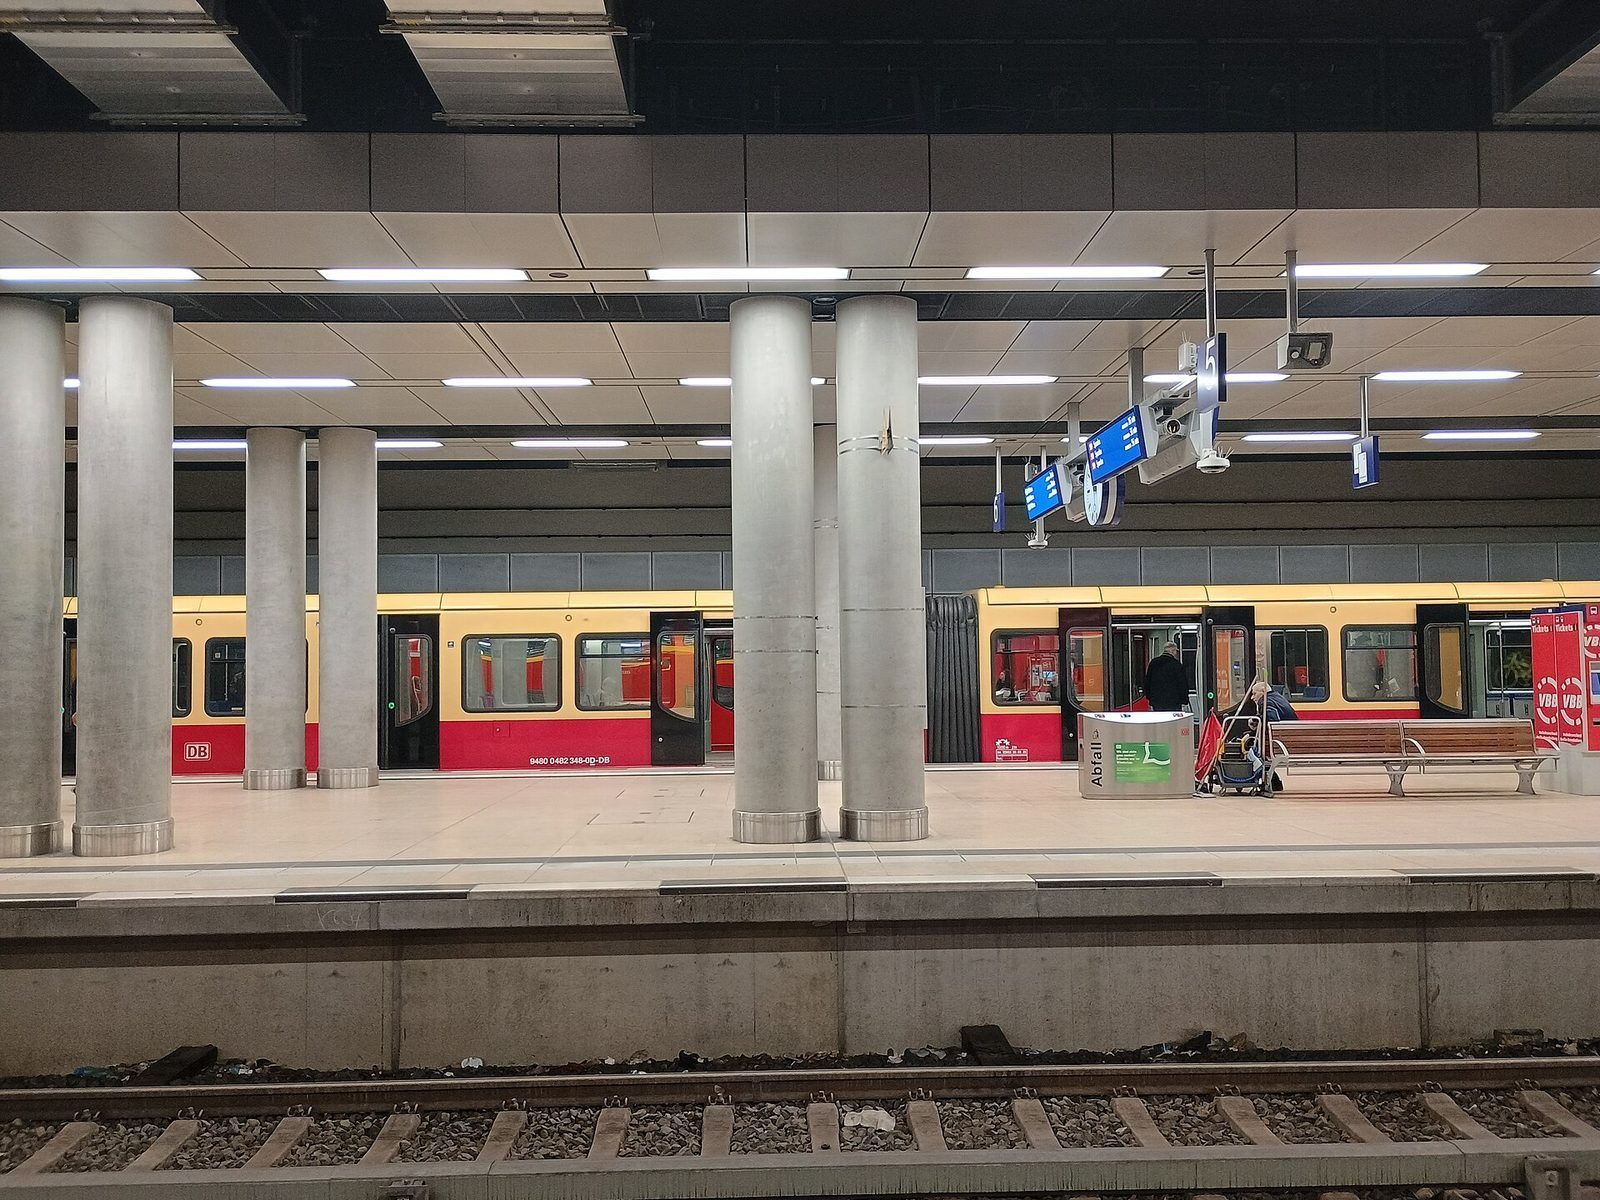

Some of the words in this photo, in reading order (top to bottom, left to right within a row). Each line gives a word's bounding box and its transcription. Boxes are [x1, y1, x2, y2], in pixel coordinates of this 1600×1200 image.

[1205, 338, 1216, 391] 5
[1584, 636, 1600, 647] VB
[187, 745, 208, 758] DB
[1090, 742, 1103, 788] Abfall
